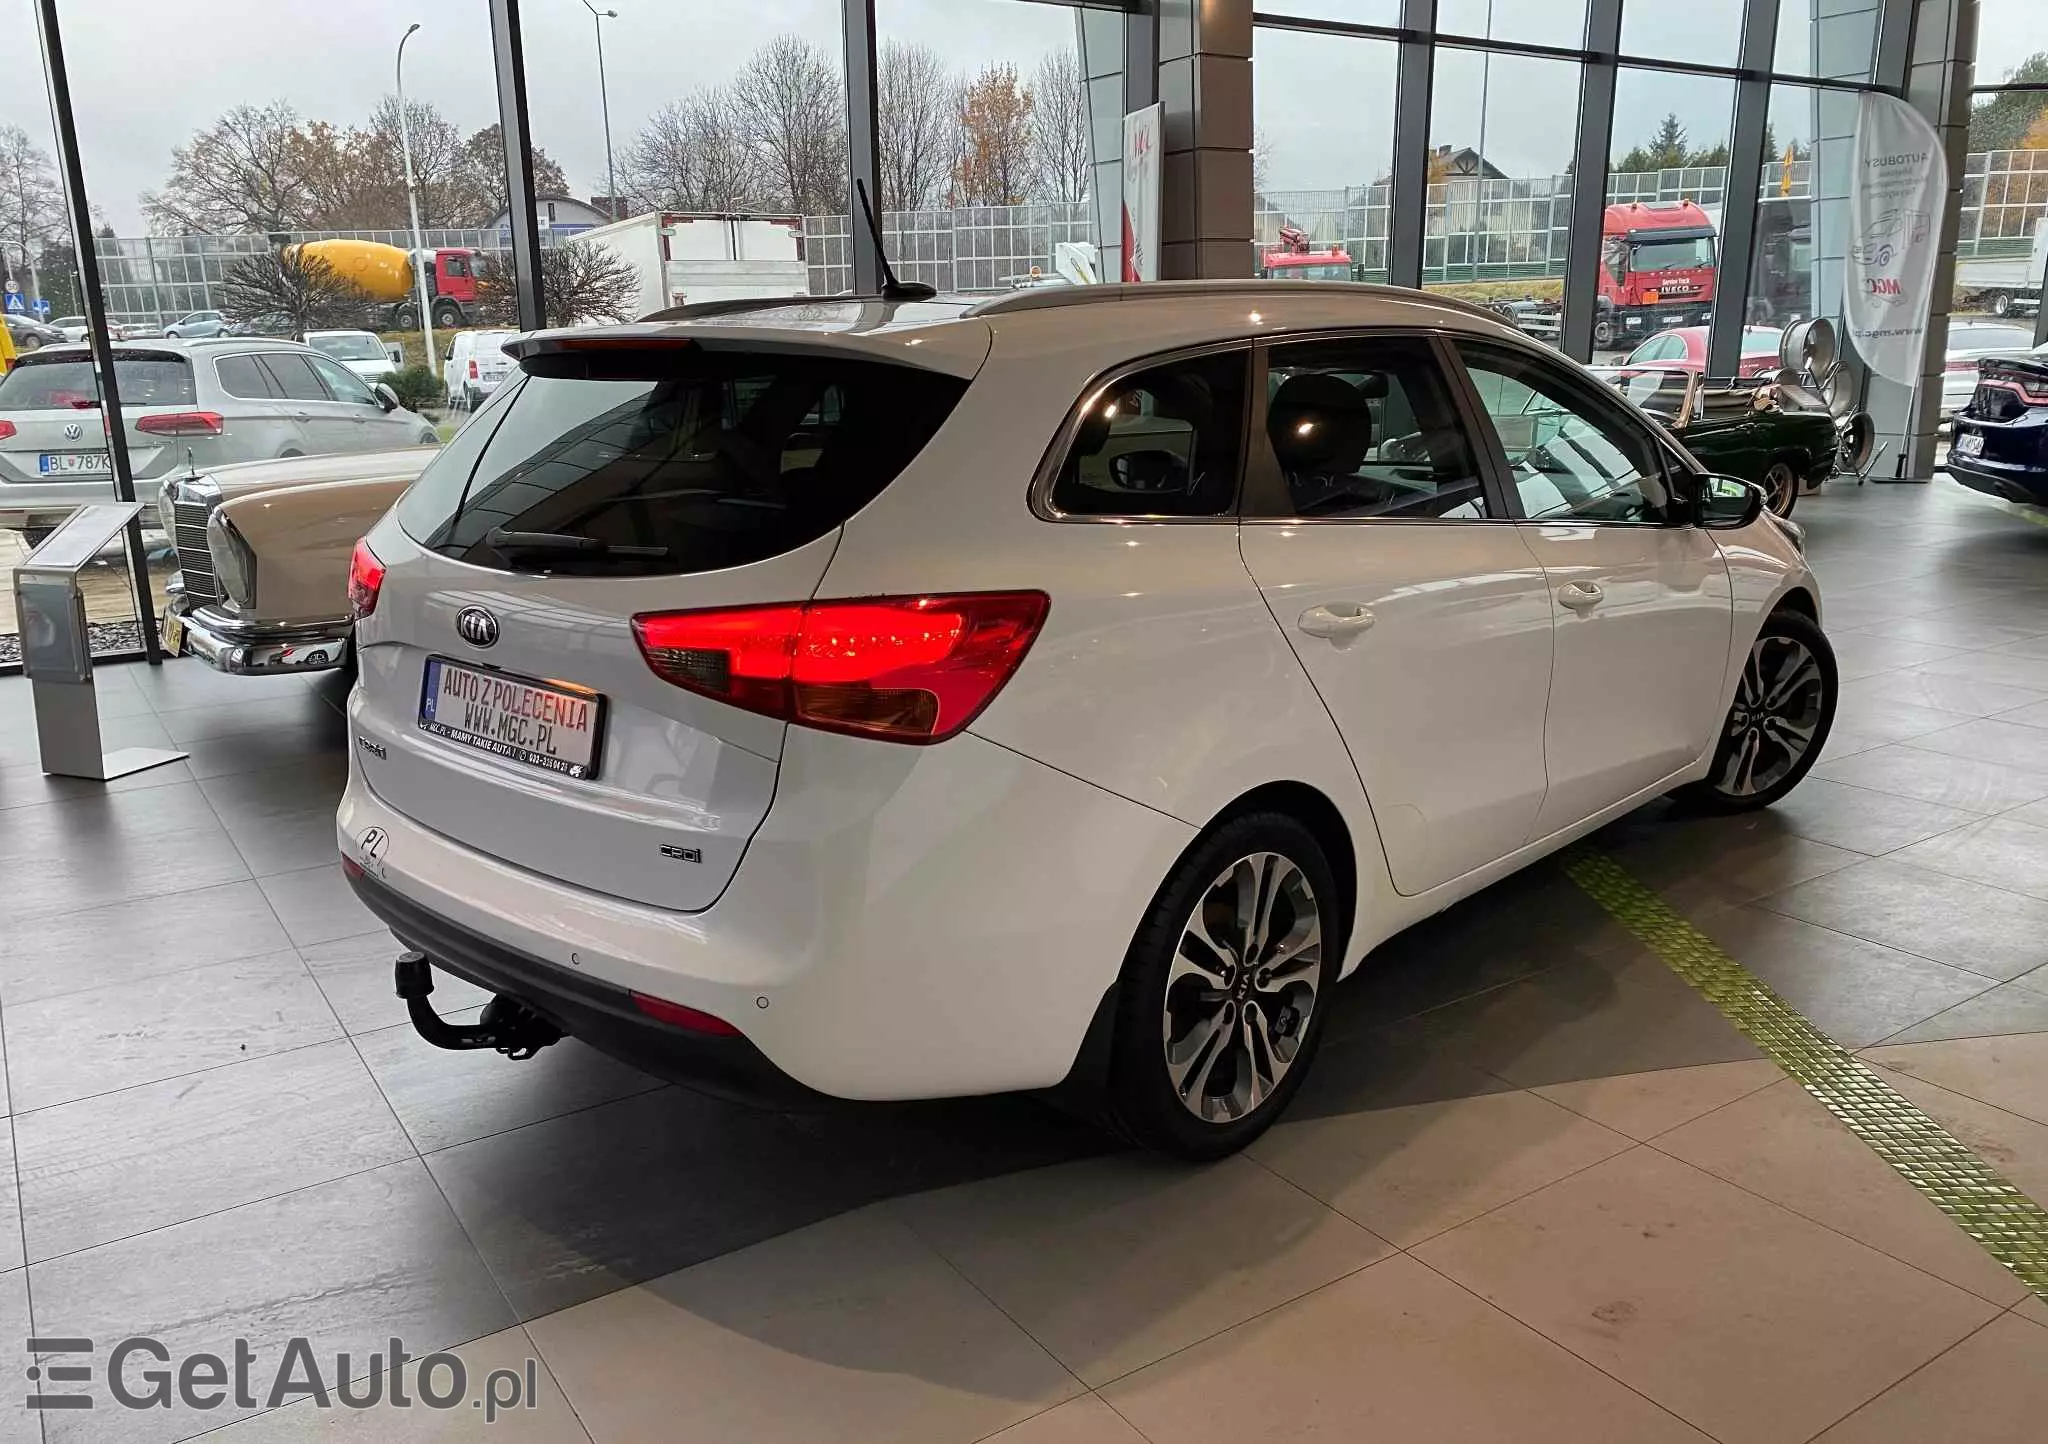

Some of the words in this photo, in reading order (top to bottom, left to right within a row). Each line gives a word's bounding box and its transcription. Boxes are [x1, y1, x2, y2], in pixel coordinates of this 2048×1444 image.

[49, 456, 68, 471] BL
[461, 613, 490, 641] KIA
[426, 698, 436, 713] PL
[444, 668, 479, 702] AUTO
[479, 677, 493, 706] Z
[493, 682, 587, 732] POLECENIA
[450, 729, 473, 744] MAMY
[472, 735, 492, 750] TAKIE
[464, 701, 557, 756] WWW.MGC.PL
[361, 829, 384, 859] PL
